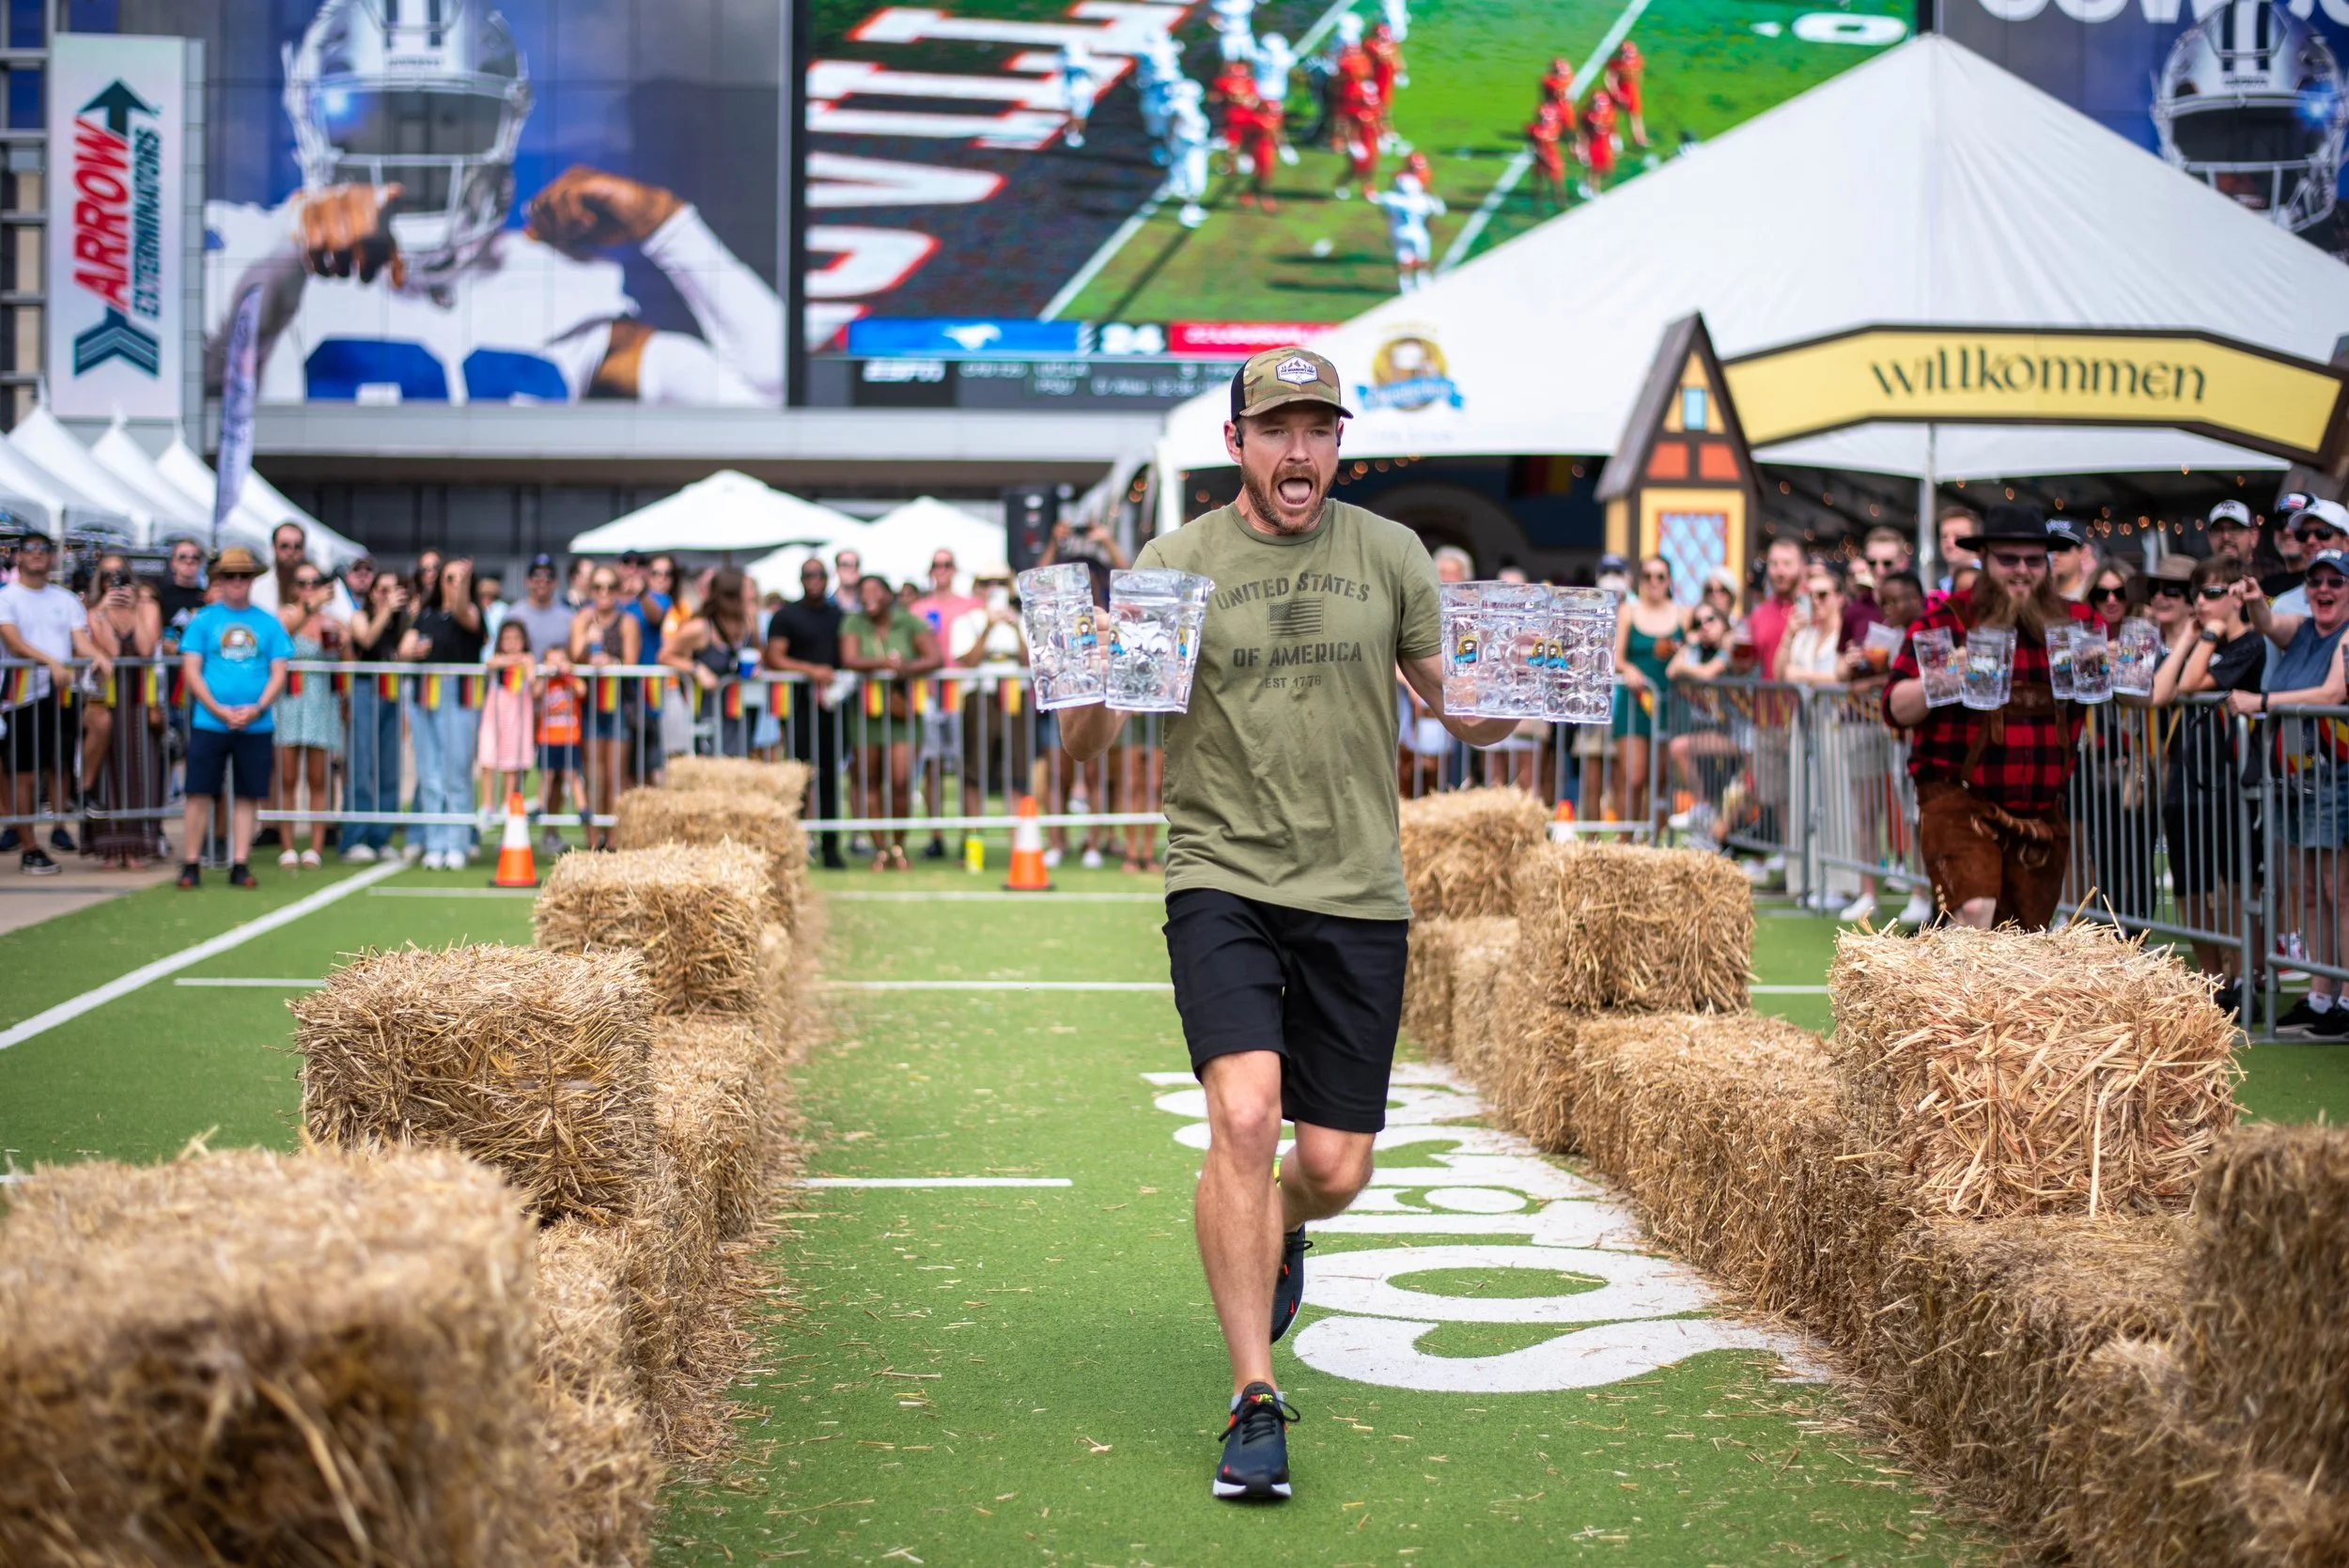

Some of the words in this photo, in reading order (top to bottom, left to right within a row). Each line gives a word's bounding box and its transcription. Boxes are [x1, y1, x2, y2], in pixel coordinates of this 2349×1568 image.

[74, 115, 130, 316] ARROW
[132, 124, 161, 323] EXTERMINATORS
[1871, 345, 2207, 405] willkommen
[1215, 577, 1289, 611] UNITED
[1297, 572, 1370, 602] STATES
[1233, 648, 1260, 667] OF
[1268, 642, 1362, 666] AMERICA
[1265, 677, 1287, 689] EST
[1293, 675, 1321, 688] 1776
